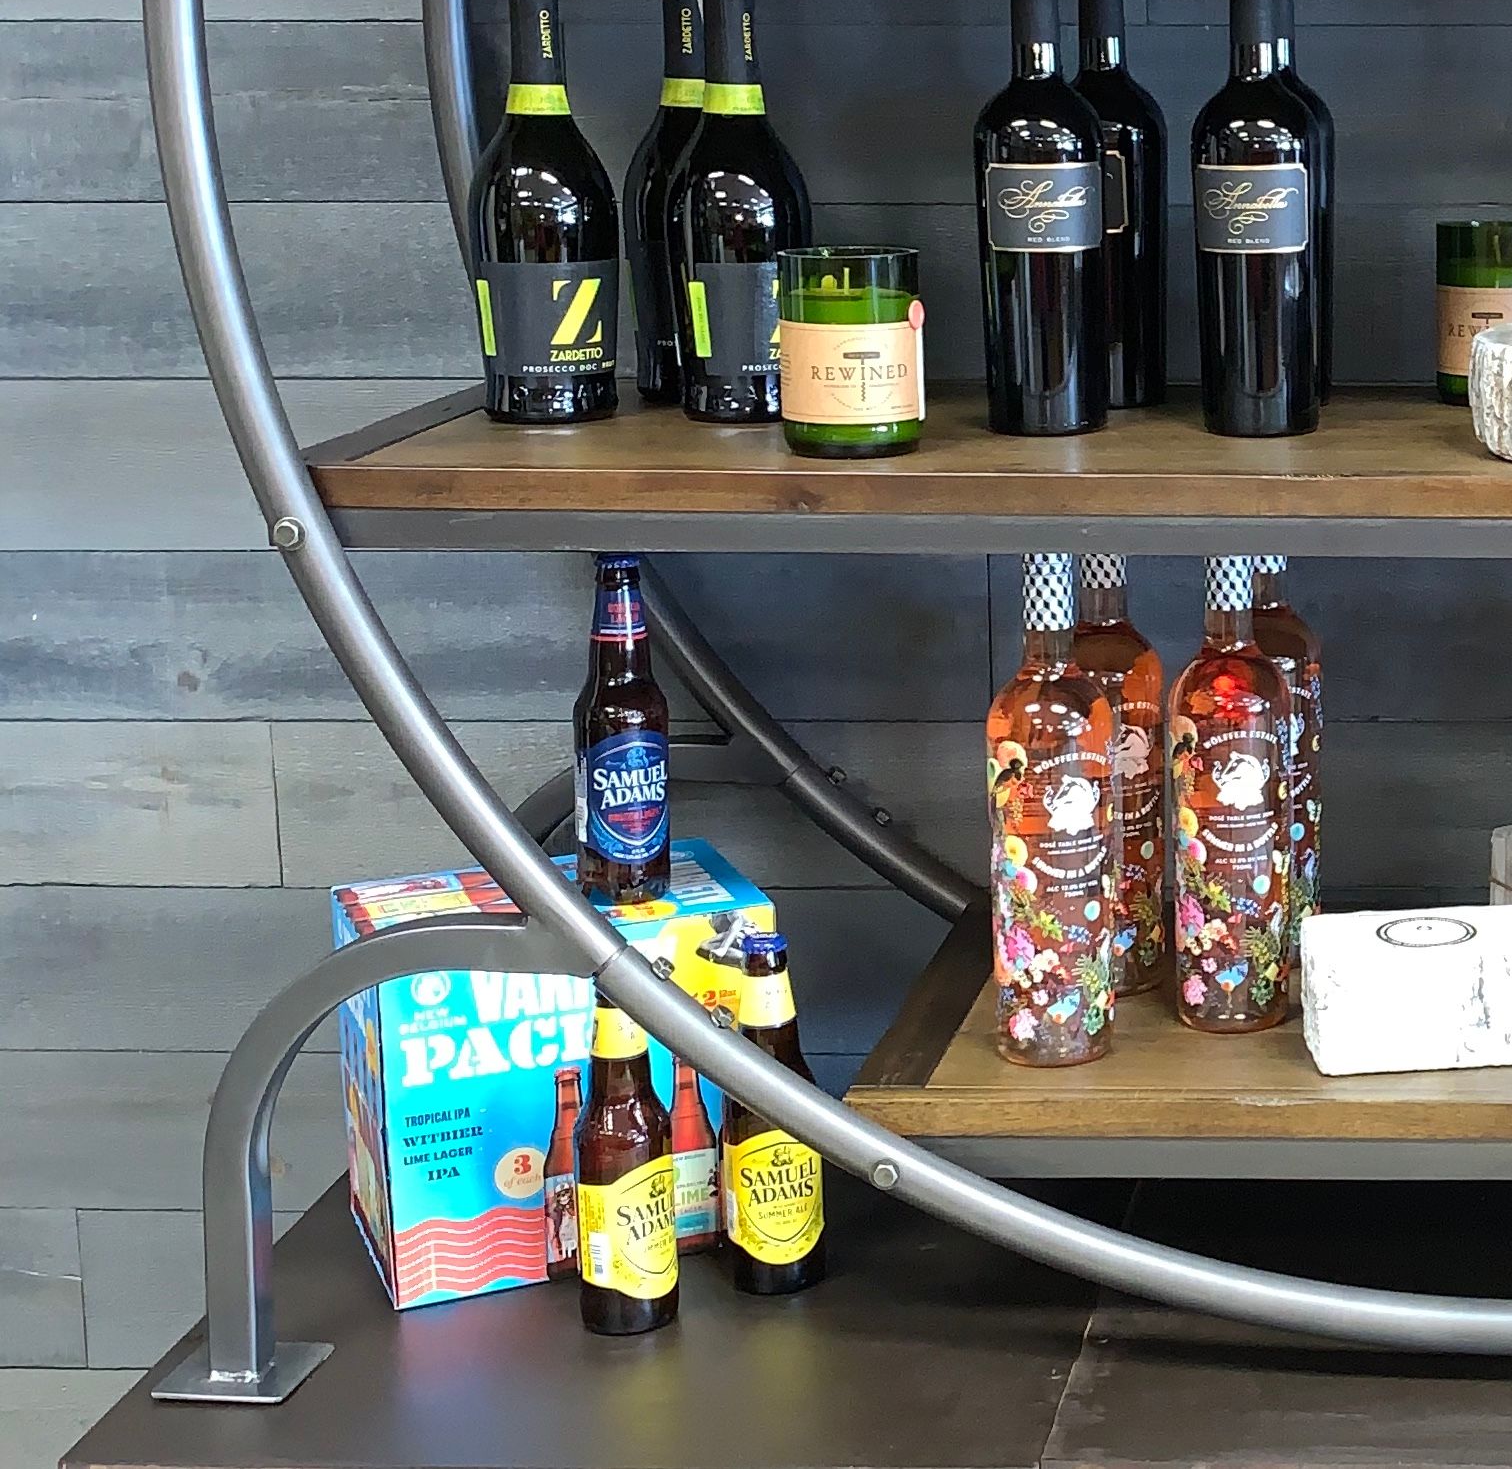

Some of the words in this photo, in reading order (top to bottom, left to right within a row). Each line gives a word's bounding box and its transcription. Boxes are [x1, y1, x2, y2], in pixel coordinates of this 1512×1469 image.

[538, 9, 554, 59] ZARDETTO
[680, 7, 693, 55] ZARDETTO
[741, 12, 754, 62] ZARDETTO
[551, 346, 604, 362] ZARDETTO
[522, 364, 576, 373] PROSECCO
[579, 363, 598, 372] DOC
[811, 363, 908, 381] REWINED
[1249, 730, 1278, 744] ESTATE
[1081, 752, 1107, 766] ESTATE
[593, 760, 668, 791] SAMUEL
[600, 782, 666, 811] ADAMS
[1202, 829, 1234, 852] SUMMER
[1253, 821, 1279, 849] BOTTLE
[1084, 845, 1107, 874] BOTTLE
[413, 1007, 449, 1020] NEW
[399, 1015, 468, 1036] BELGIUM
[405, 1111, 451, 1128] TROPICAL
[454, 1106, 471, 1119] IPA
[403, 1125, 484, 1148] WITBIER
[403, 1153, 430, 1166] LIME
[433, 1146, 473, 1161] LAGER
[514, 1154, 532, 1176] 3
[427, 1166, 461, 1181] IPA
[503, 1177, 514, 1189] of
[740, 1156, 818, 1189] SAMUEL
[676, 1186, 709, 1205] IME
[748, 1177, 814, 1208] ADAMS
[757, 1209, 793, 1221] SUMMER
[795, 1202, 808, 1214] ALE
